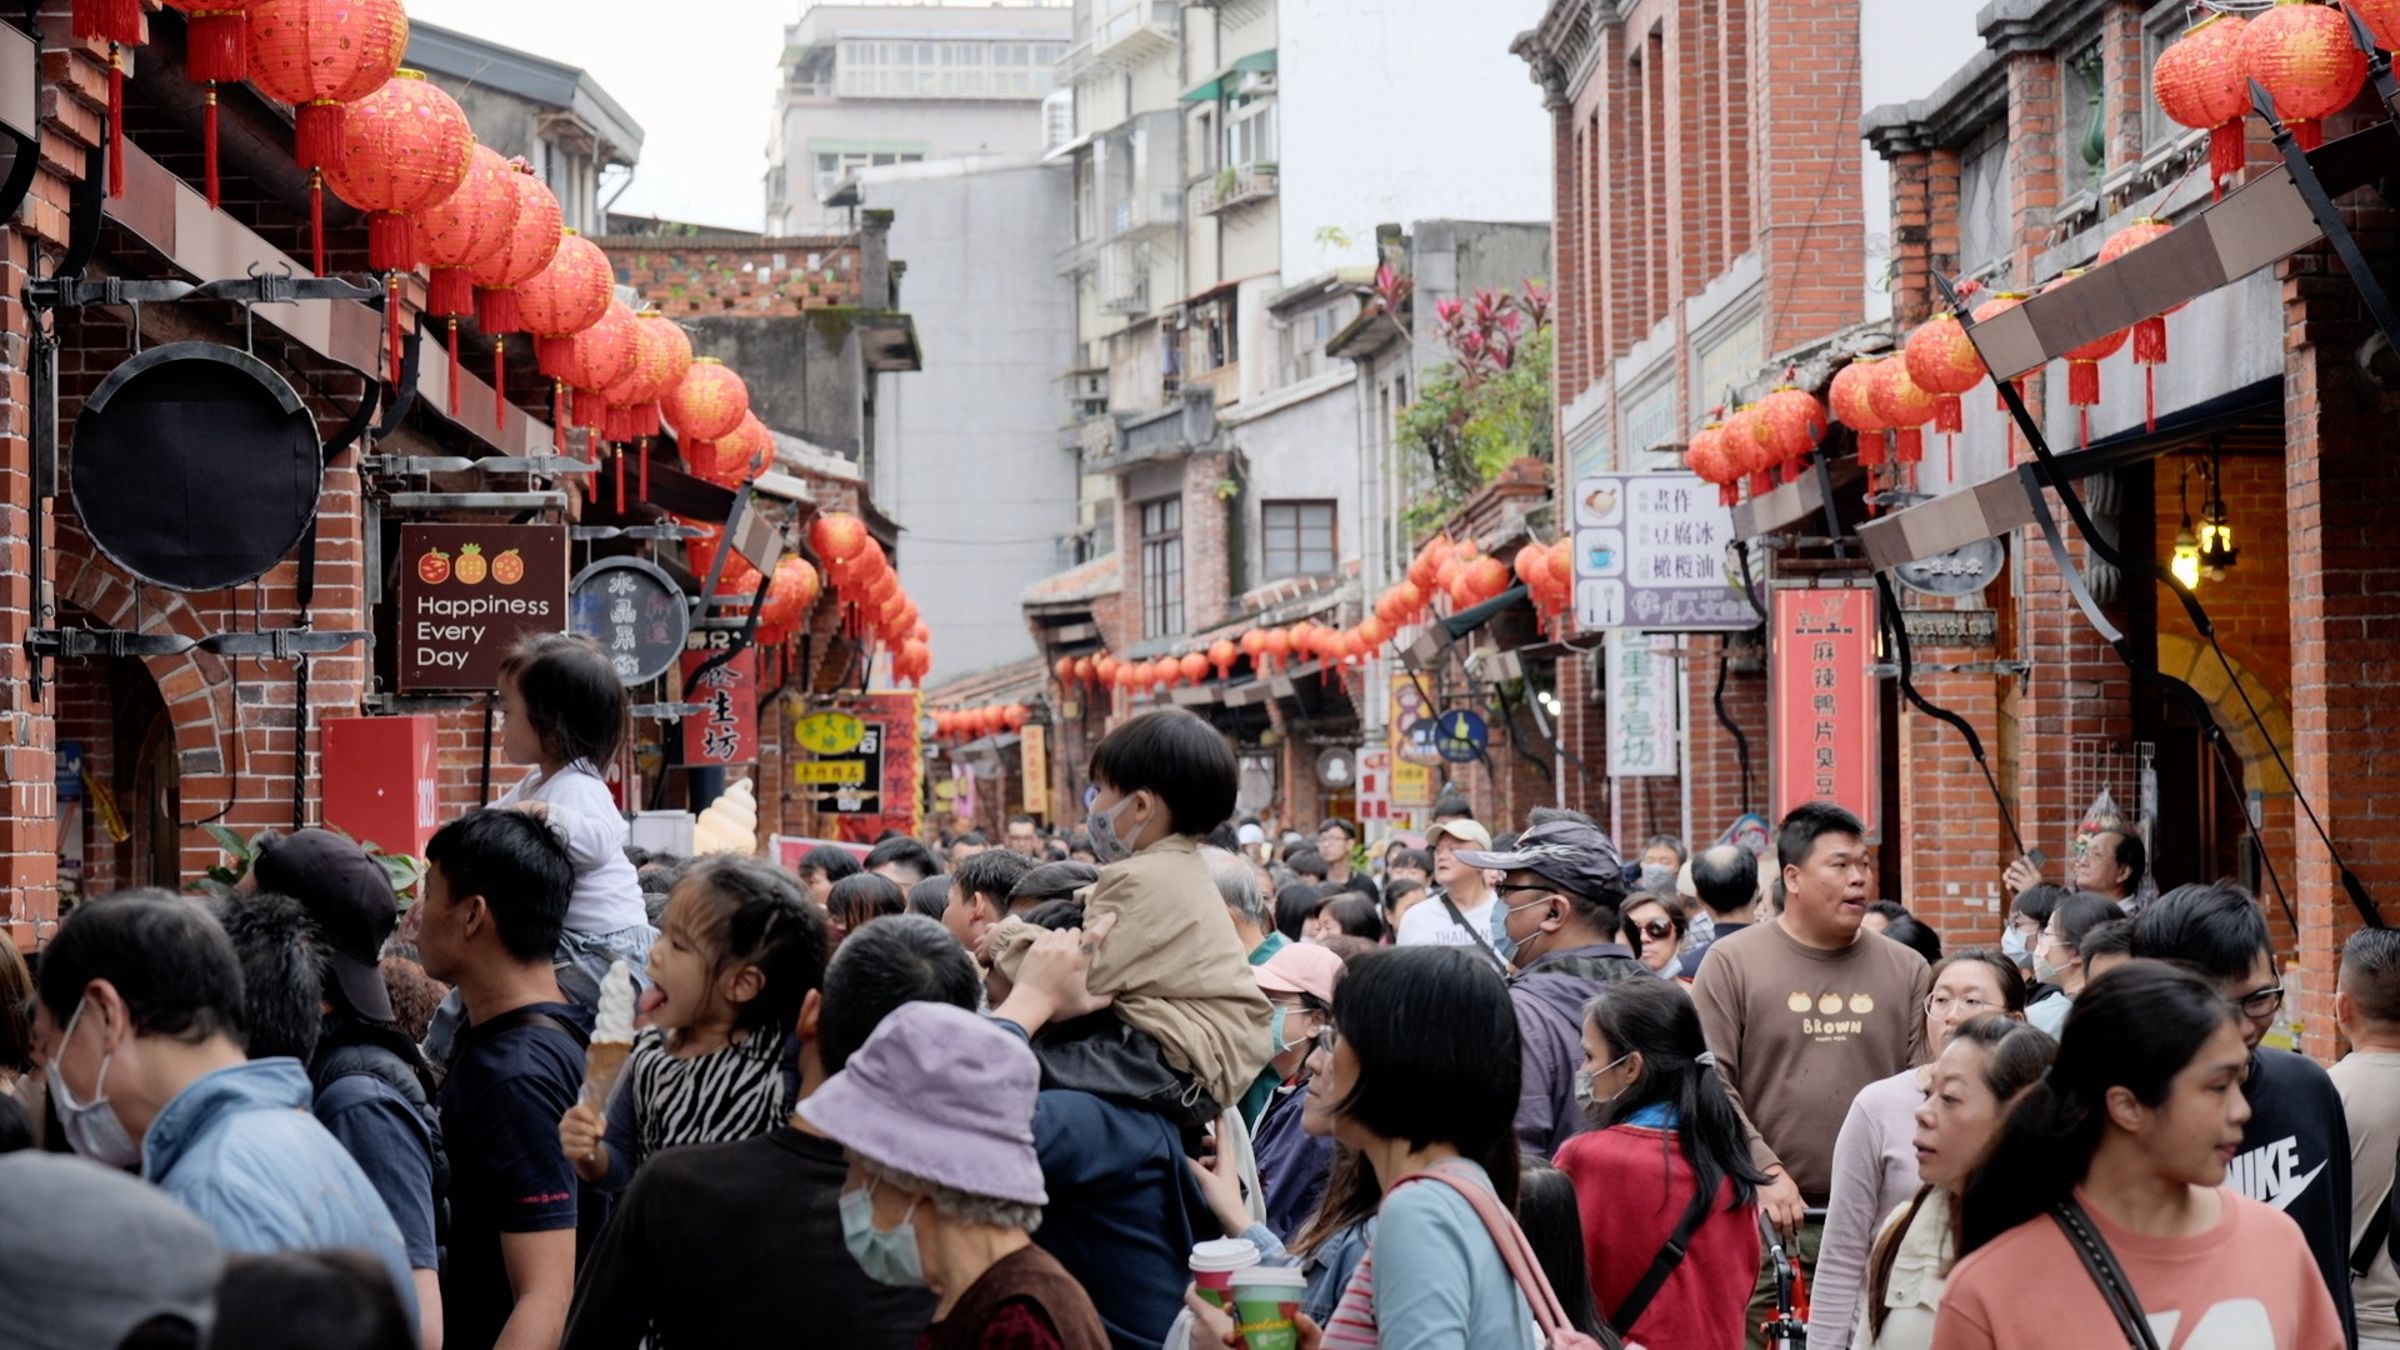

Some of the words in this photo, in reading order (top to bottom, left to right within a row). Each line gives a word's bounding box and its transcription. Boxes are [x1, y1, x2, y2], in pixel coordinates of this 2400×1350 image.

[418, 594, 550, 620] Happiness
[417, 621, 486, 645] Every
[417, 647, 469, 670] Day
[1812, 639, 1837, 803] 麻辣鴨片臭豆
[1803, 1018, 1863, 1035] BROWN
[2225, 1135, 2303, 1203] NIKE
